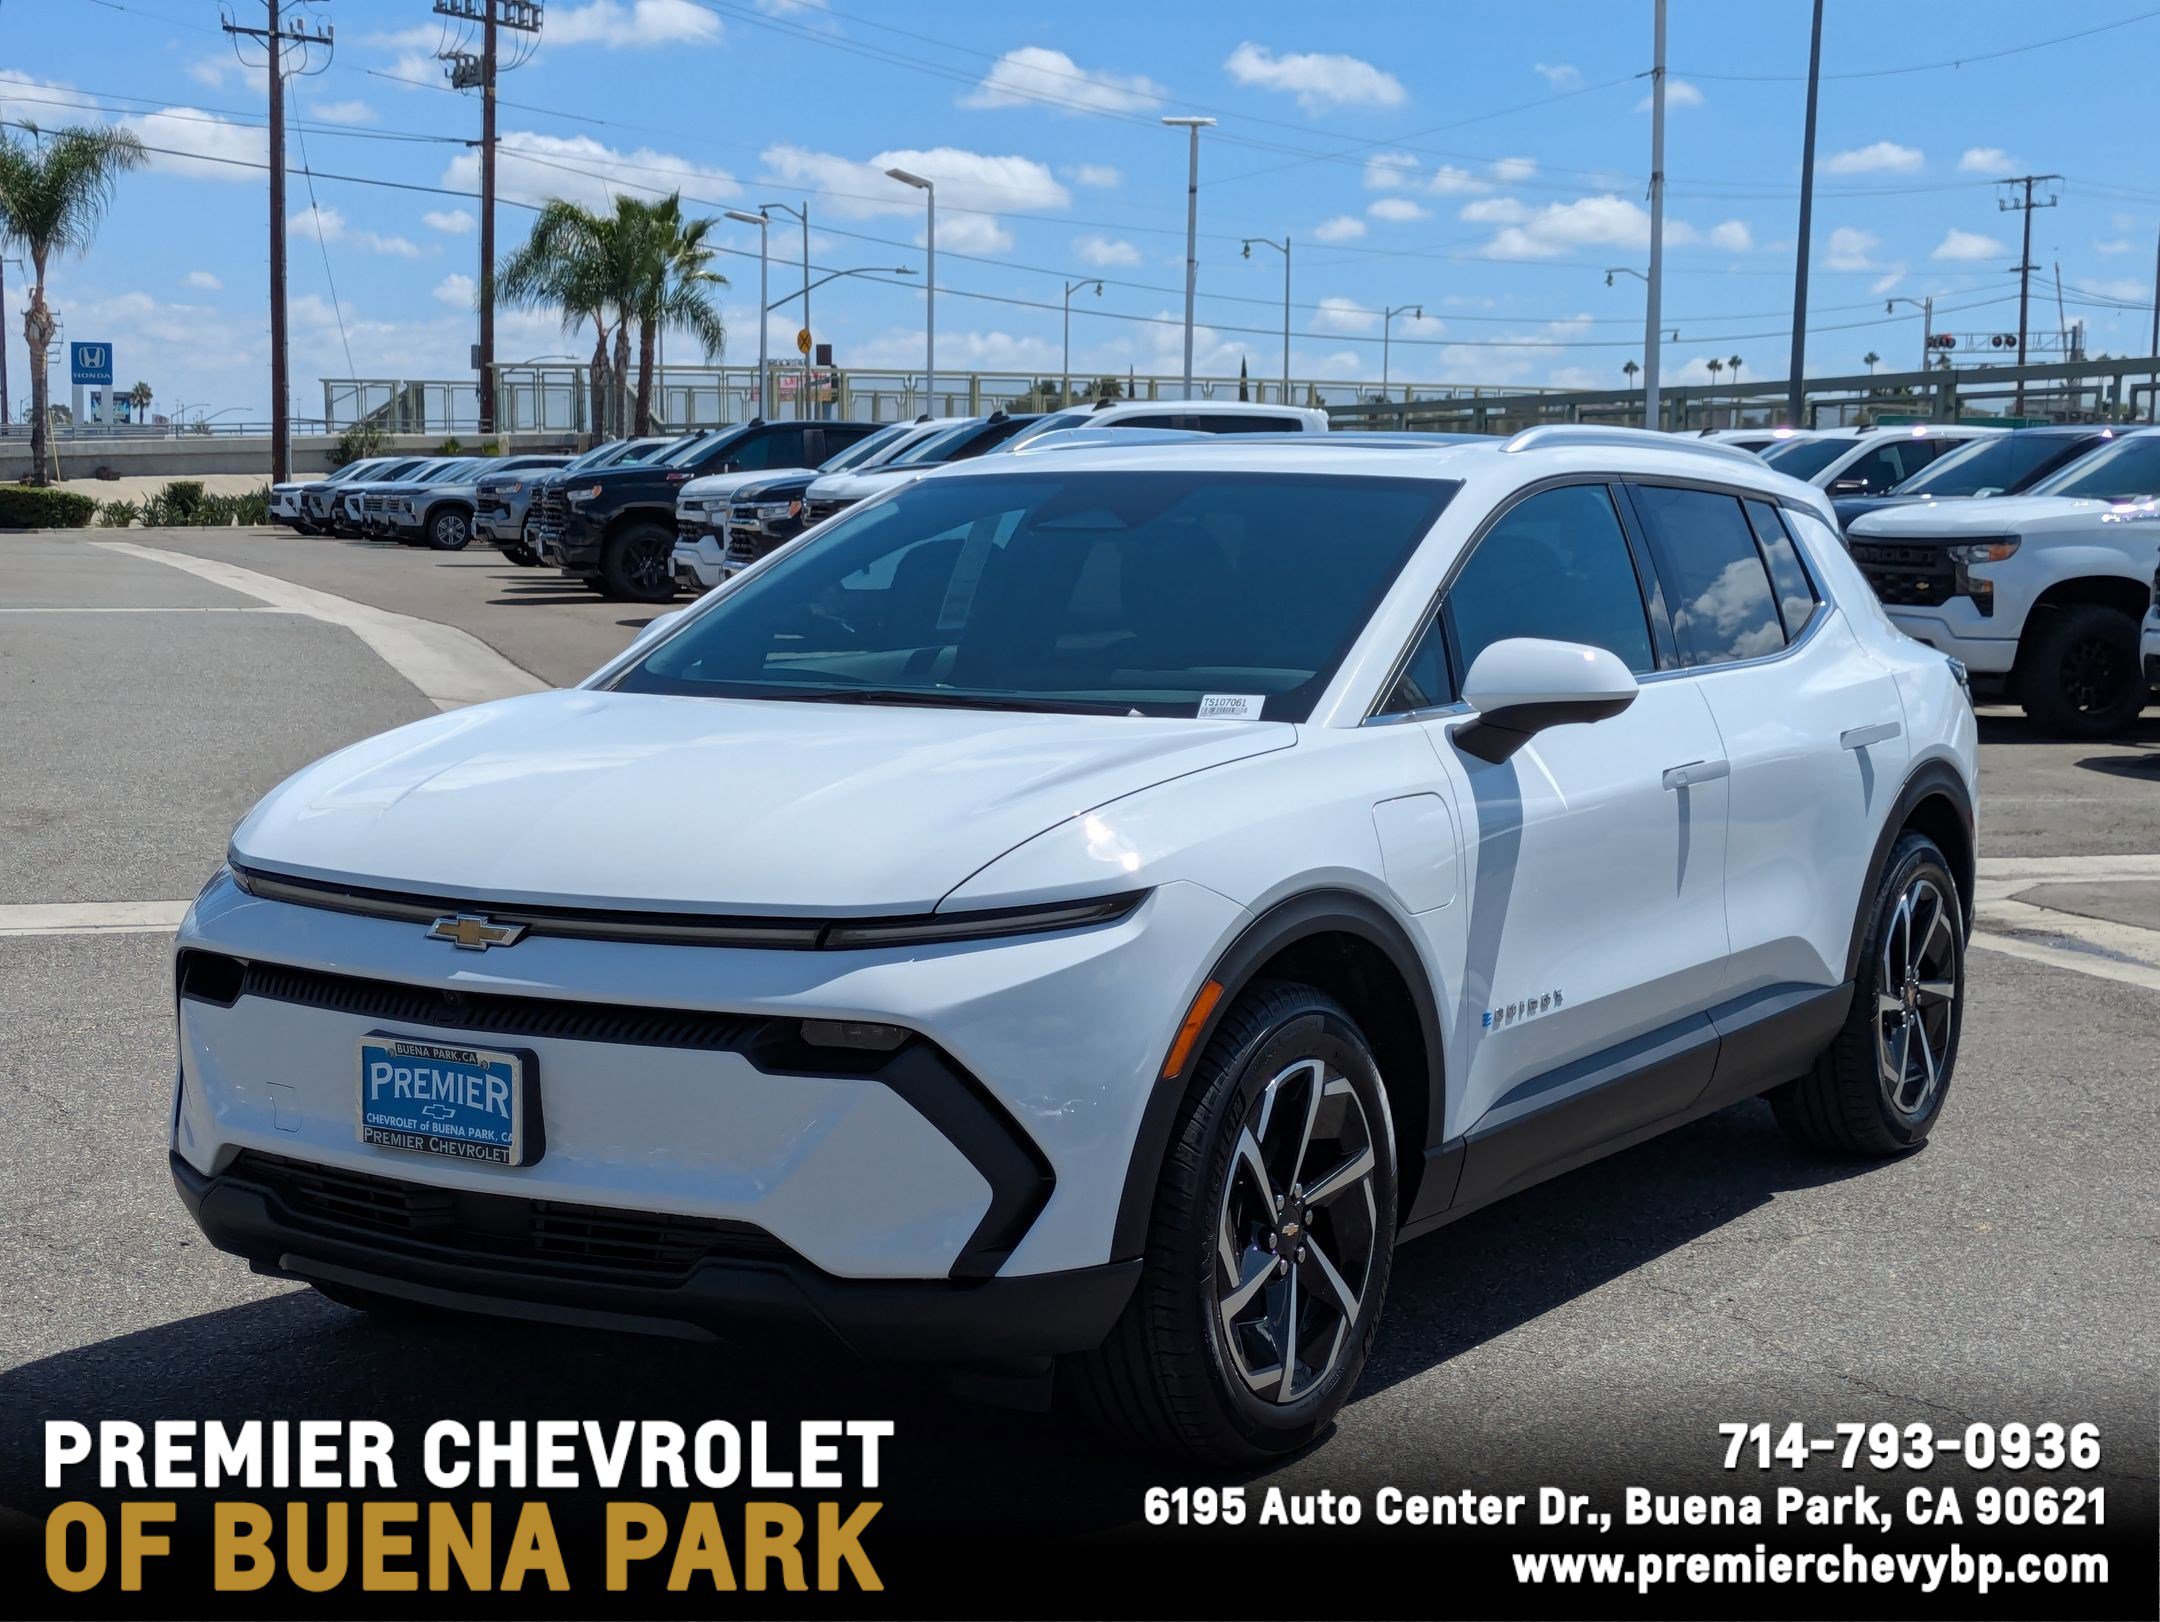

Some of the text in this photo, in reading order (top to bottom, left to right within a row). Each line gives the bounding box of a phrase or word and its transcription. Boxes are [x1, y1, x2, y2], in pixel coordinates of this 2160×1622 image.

[396, 1044, 430, 1058] BUENA
[370, 1062, 510, 1119] PREMIER
[366, 1112, 418, 1129] CHEVROLET
[420, 1120, 431, 1130] of
[432, 1123, 466, 1137] BUENA
[468, 1128, 499, 1142] PARK,
[364, 1128, 510, 1162] PREMIER CHEVROLET
